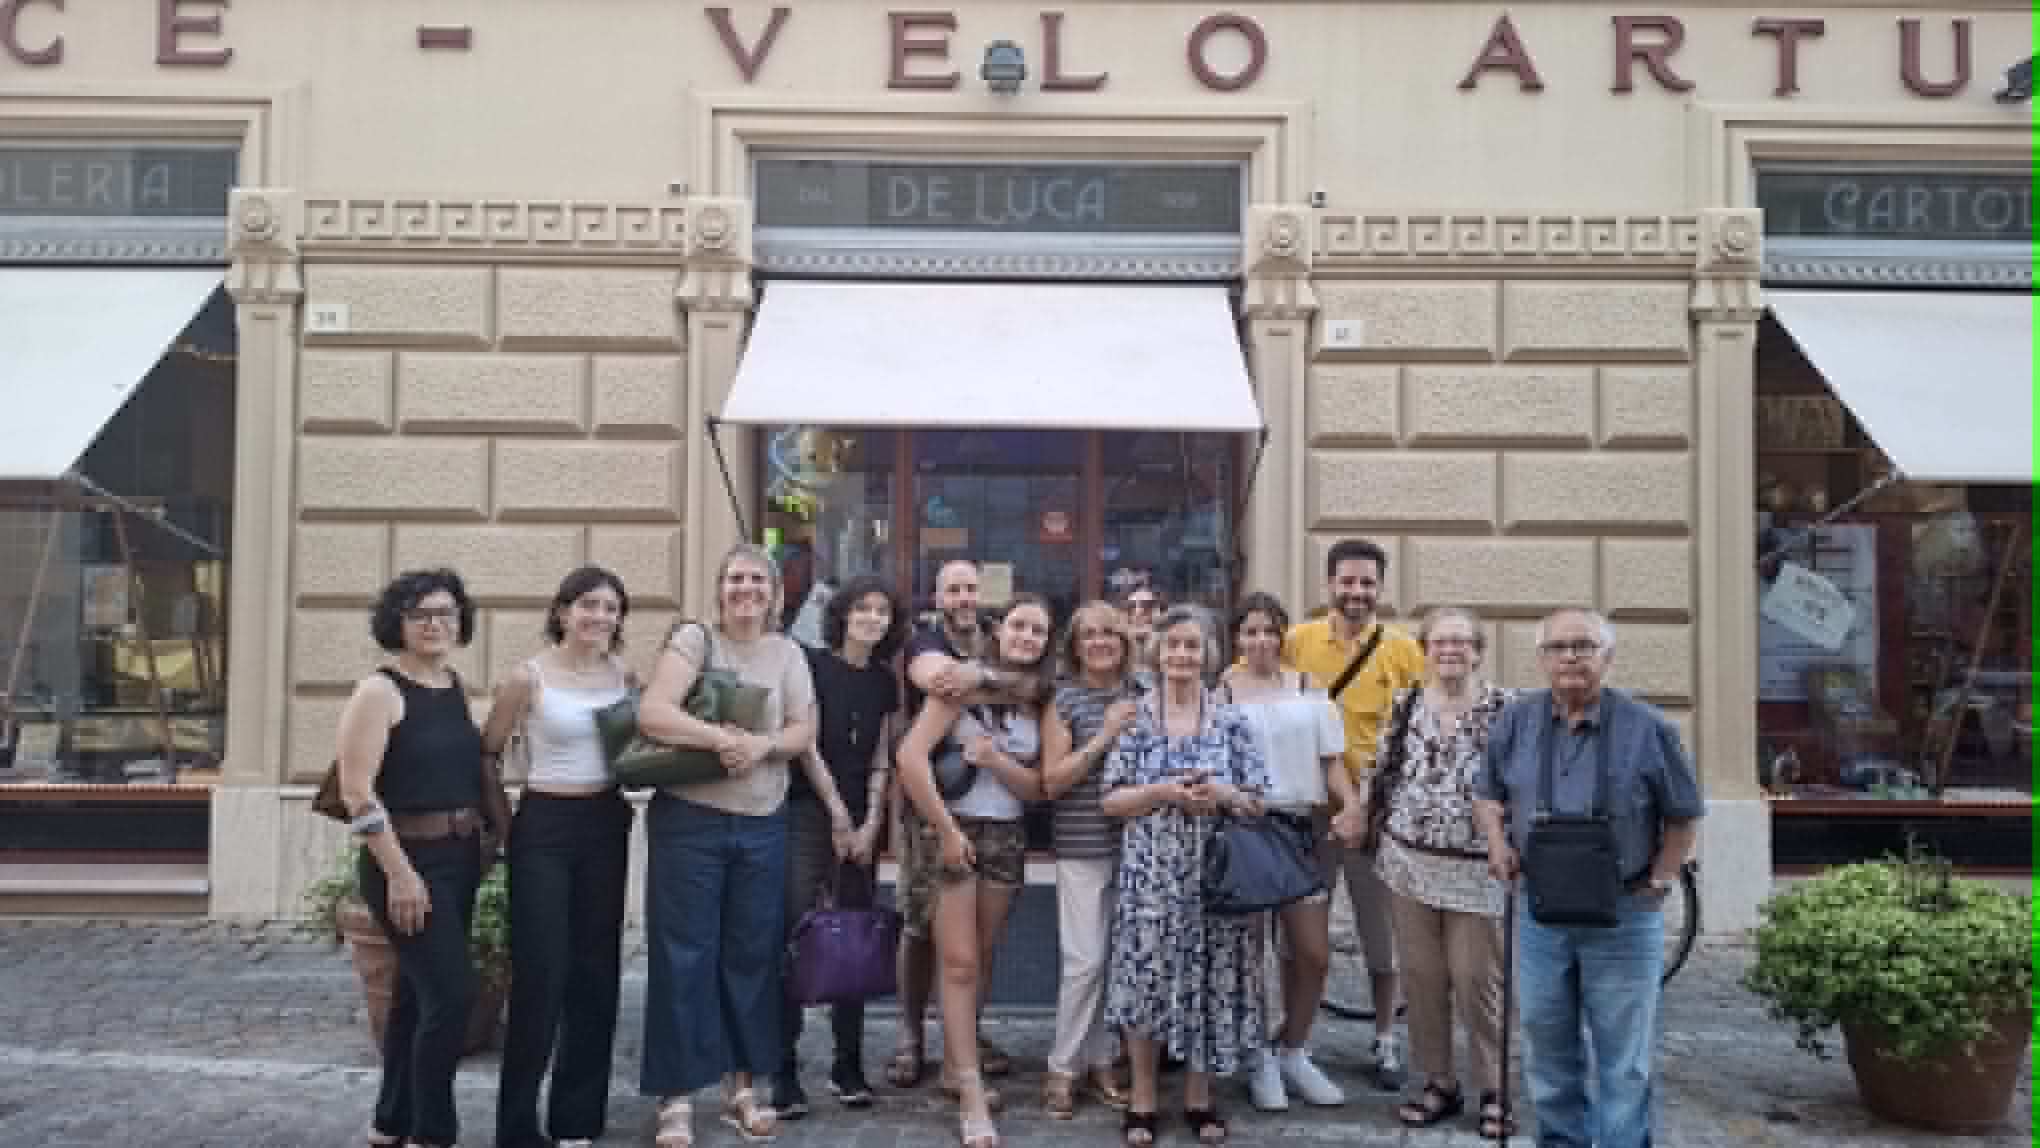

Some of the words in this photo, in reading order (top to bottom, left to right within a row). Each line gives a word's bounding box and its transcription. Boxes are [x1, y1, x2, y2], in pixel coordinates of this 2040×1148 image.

[704, 7, 1269, 91] VELO
[1458, 14, 1974, 97] ARTU
[0, 158, 169, 208] LERIA
[886, 174, 954, 218] DE
[975, 169, 1107, 224] LUCA
